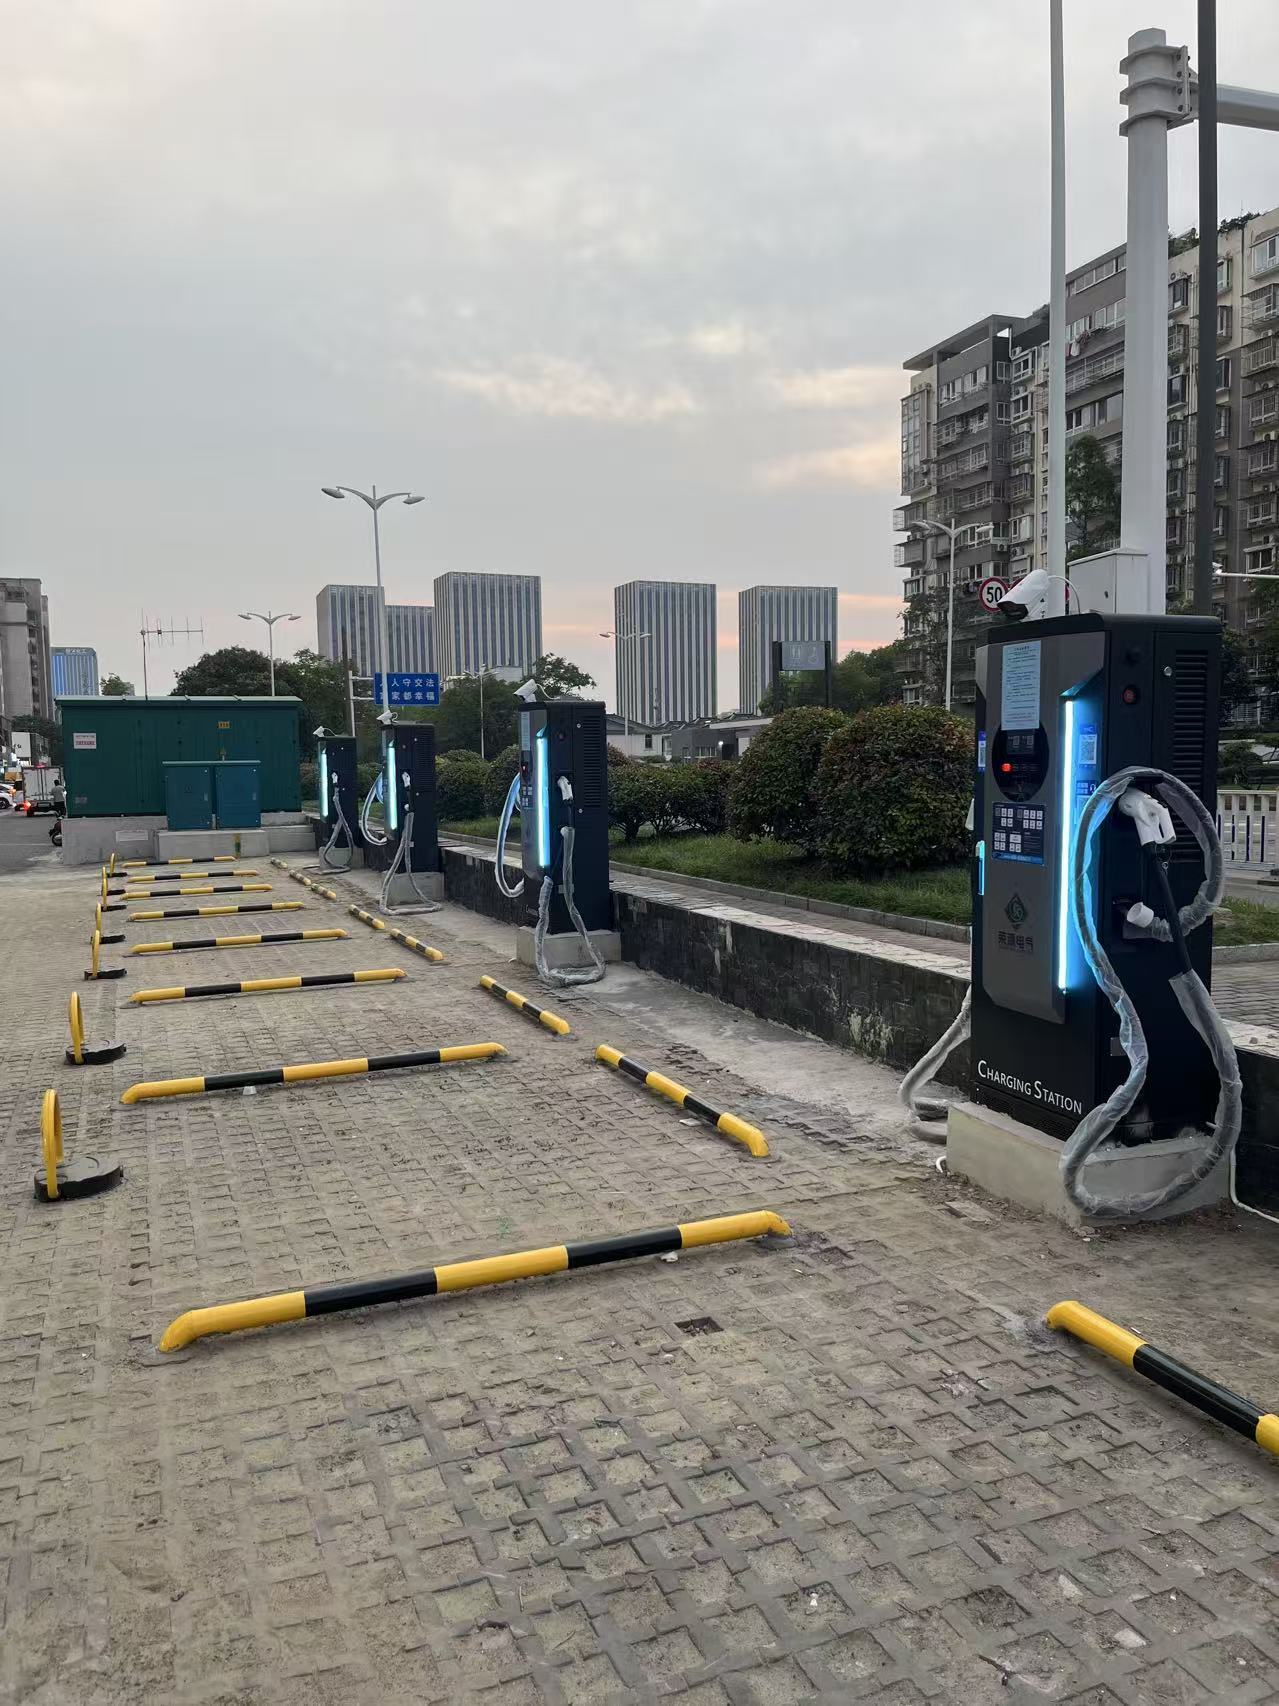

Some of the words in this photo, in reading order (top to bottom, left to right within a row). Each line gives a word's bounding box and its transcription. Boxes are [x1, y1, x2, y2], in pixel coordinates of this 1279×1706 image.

[986, 586, 1003, 603] 50
[379, 678, 435, 687] 人守交法
[977, 1059, 1032, 1095] CHARGING
[1033, 1080, 1082, 1115] STATION
